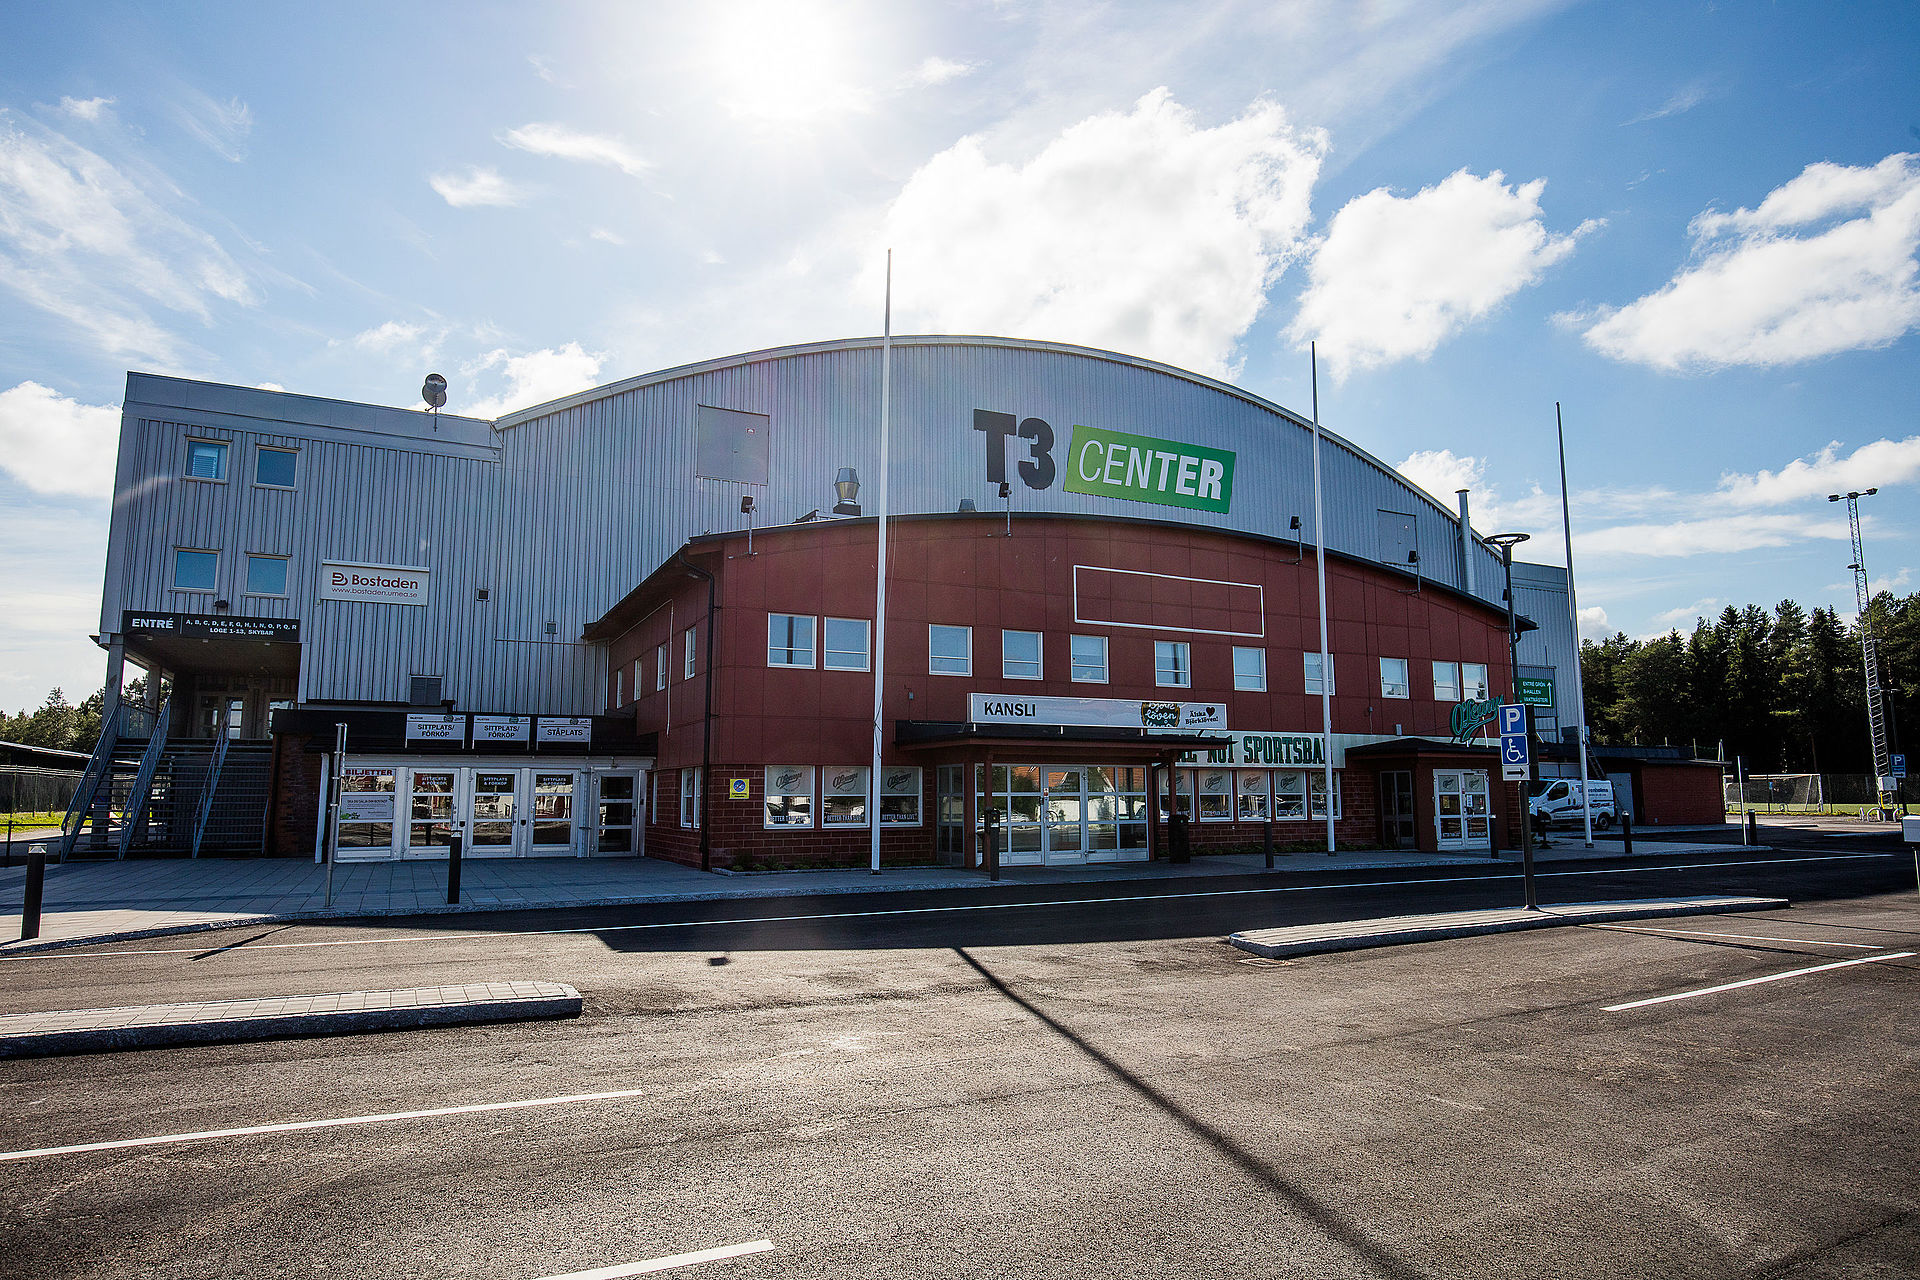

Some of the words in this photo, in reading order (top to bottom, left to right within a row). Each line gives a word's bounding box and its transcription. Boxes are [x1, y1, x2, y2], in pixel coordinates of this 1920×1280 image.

[973, 408, 1056, 490] T3
[1078, 440, 1225, 500] CENTER
[352, 574, 418, 590] Bostaden
[131, 617, 174, 629] ENTRÉ
[984, 701, 1036, 717] KANSLI
[1189, 710, 1207, 718] Älska
[1505, 708, 1521, 732] P
[417, 723, 456, 731] SITTPLATS/
[484, 724, 520, 732] SITTPLATS/
[547, 727, 584, 736] STÅPLATS
[1894, 756, 1902, 765] P
[344, 768, 393, 776] BILJETTER
